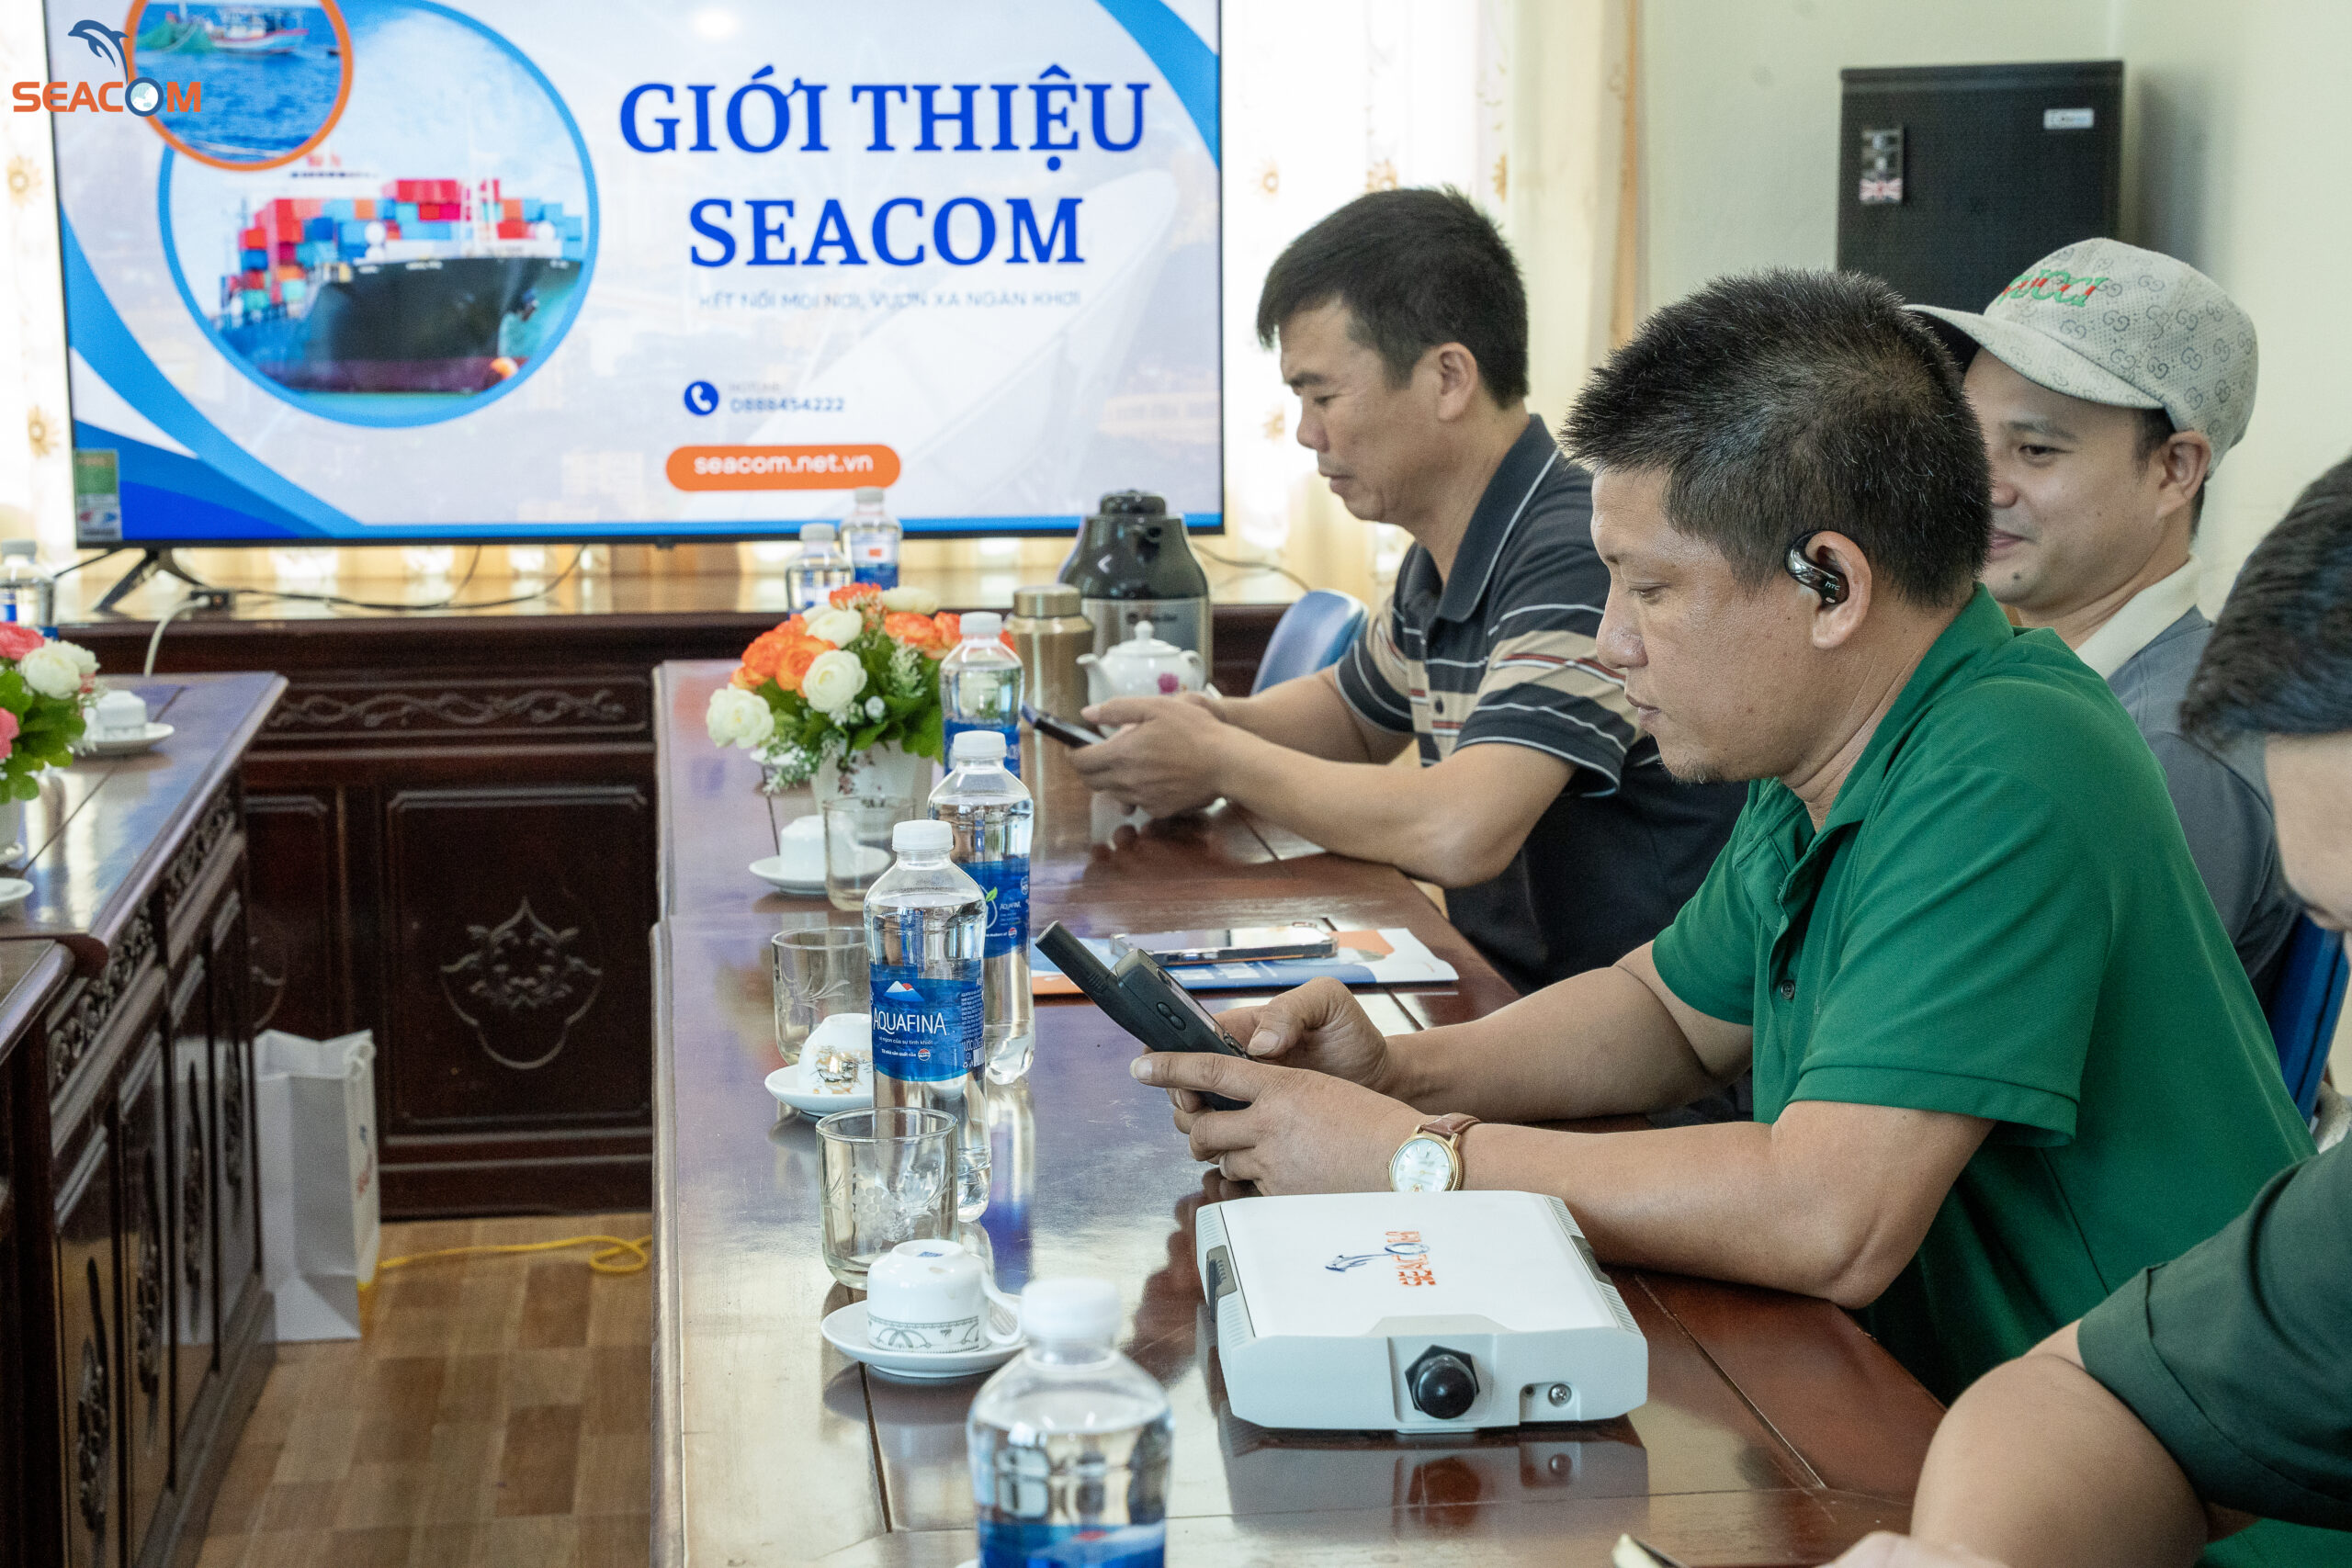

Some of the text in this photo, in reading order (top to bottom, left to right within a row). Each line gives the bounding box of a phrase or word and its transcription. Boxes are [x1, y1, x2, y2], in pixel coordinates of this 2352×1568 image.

[619, 63, 1150, 172] GIỚI THIỆU
[688, 197, 1085, 267] SEACOM
[694, 453, 874, 475] seacom.net.vn
[873, 1007, 947, 1036] AQUAFINA
